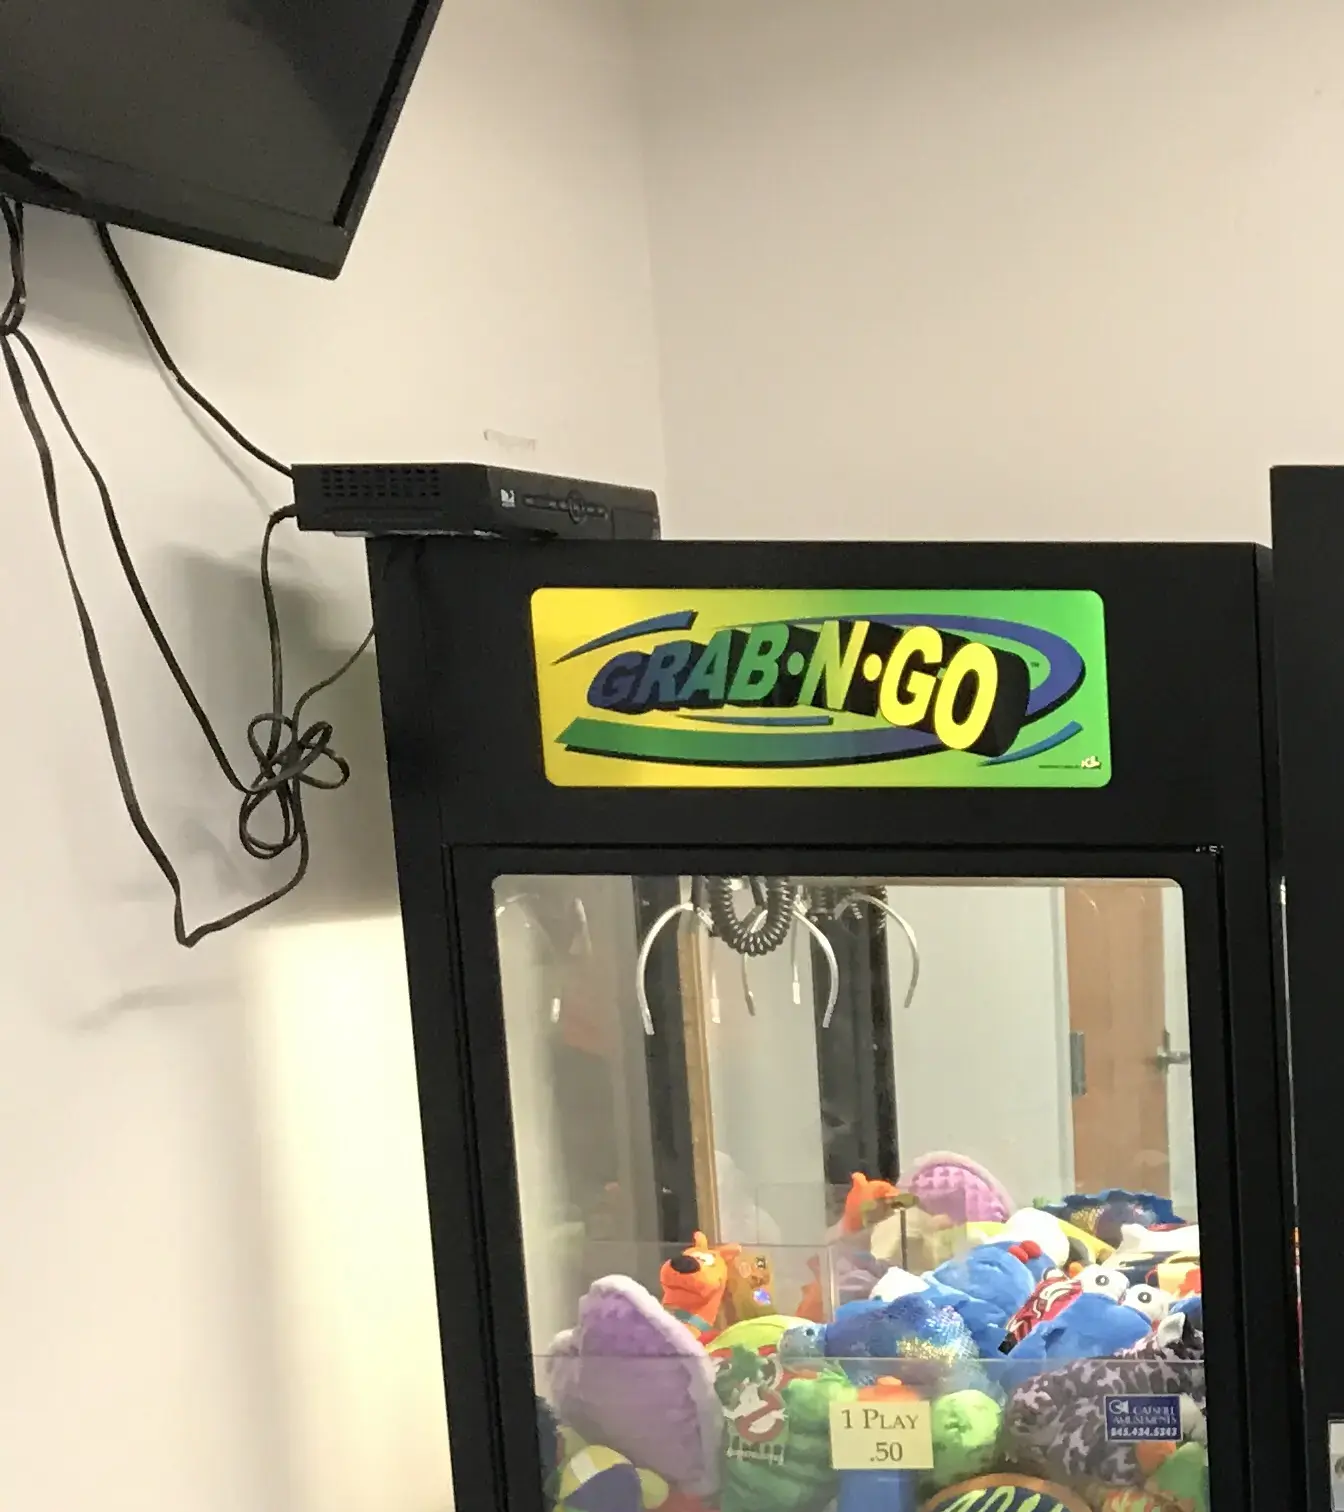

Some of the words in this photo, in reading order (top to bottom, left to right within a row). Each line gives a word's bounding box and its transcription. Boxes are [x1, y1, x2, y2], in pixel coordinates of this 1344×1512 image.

[842, 1409, 851, 1430] 1
[863, 1408, 920, 1430] PLAY
[870, 1442, 903, 1462] .50
